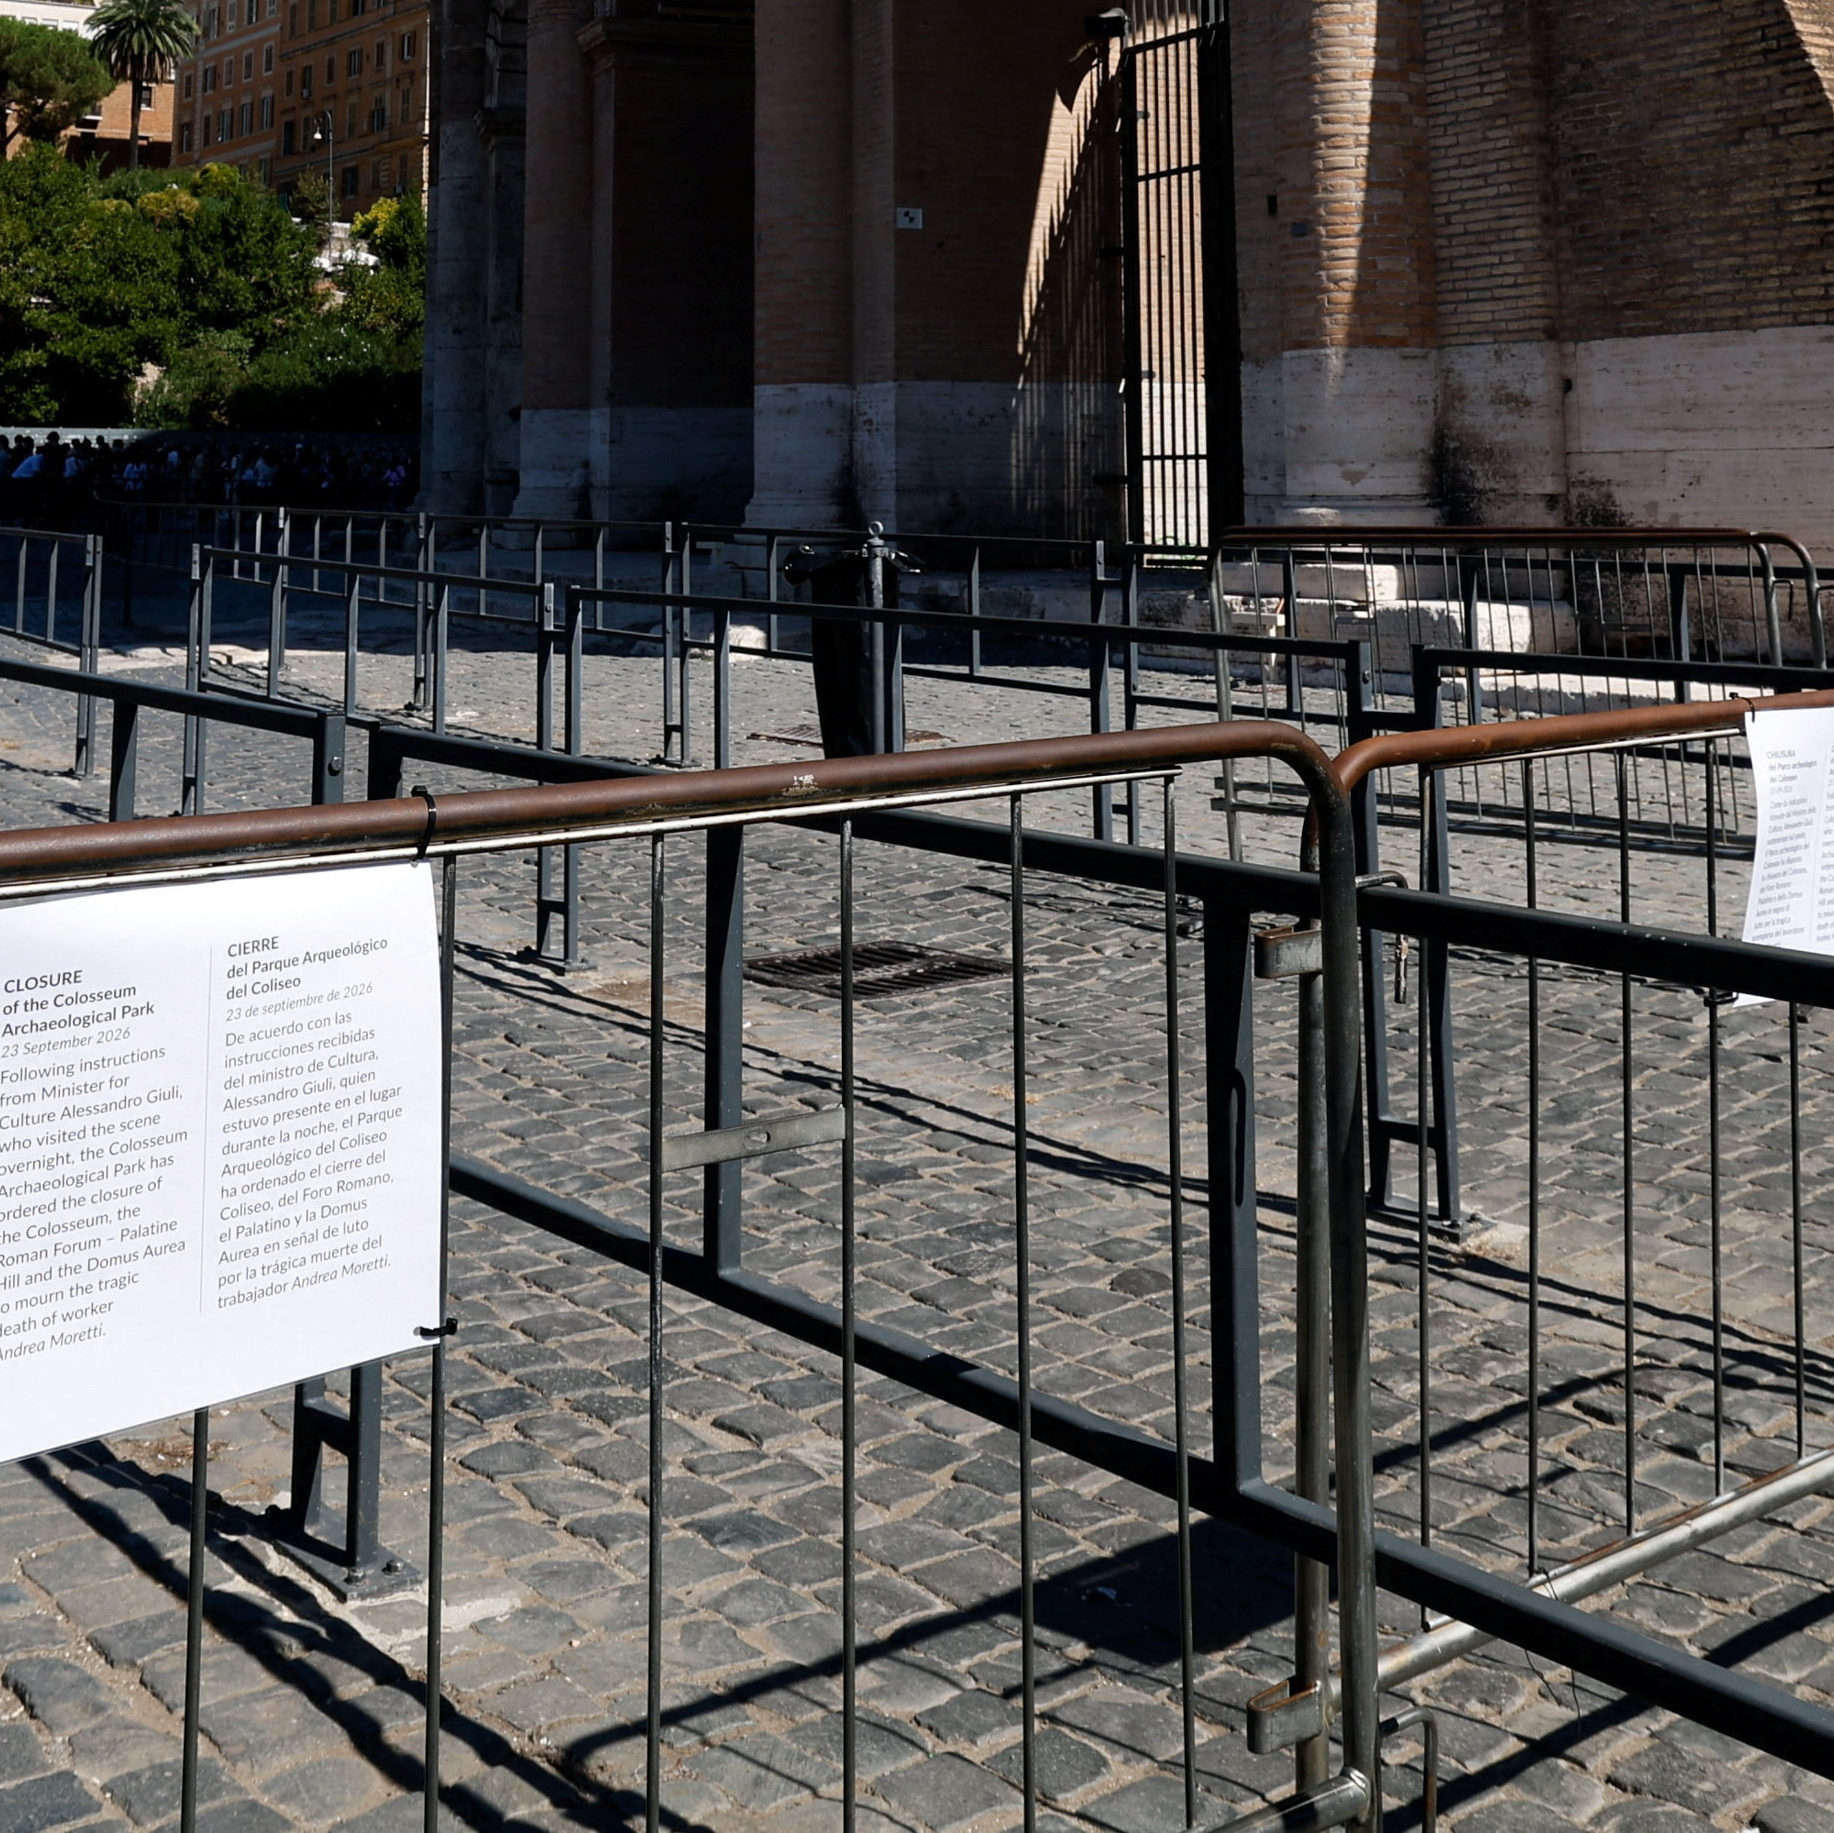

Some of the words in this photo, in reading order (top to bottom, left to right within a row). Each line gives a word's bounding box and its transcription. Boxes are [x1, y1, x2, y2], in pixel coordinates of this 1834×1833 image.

[227, 962, 248, 979] del
[252, 957, 299, 974] Parque
[302, 938, 387, 965] Arqueológico
[228, 936, 279, 957] CIERRE
[4, 970, 83, 993] CLOSURE
[226, 983, 247, 1000] del
[251, 977, 301, 995] Coliseo
[3, 1000, 20, 1015] of
[23, 998, 49, 1012] the
[53, 986, 136, 1008] Colosseum
[226, 1007, 241, 1022] 23
[245, 1005, 259, 1018] de
[262, 994, 324, 1014] septiembre
[327, 989, 340, 1002] de
[344, 982, 372, 998] 2026
[1, 1006, 117, 1038] Archaeological
[122, 1001, 154, 1019] Park
[1, 1044, 19, 1058] 23
[23, 1035, 93, 1055] September
[96, 1026, 130, 1044] 2026
[1, 1063, 75, 1084] Following
[80, 1048, 165, 1072] instructions
[0, 1092, 36, 1107] from
[42, 1081, 105, 1101] Minister
[109, 1075, 130, 1090] for
[0, 1112, 56, 1130] Culture
[60, 1095, 142, 1121] Alessandro
[147, 1085, 182, 1103] Giuli,
[37, 1125, 86, 1146] visited
[91, 1122, 115, 1137] the
[120, 1114, 161, 1132] scene
[80, 1147, 104, 1162] the
[109, 1131, 187, 1156] Colosseum
[114, 1158, 146, 1177] Park
[150, 1155, 174, 1169] has
[218, 1272, 242, 1290] por
[246, 1266, 256, 1280] la
[261, 1256, 306, 1276] trágica
[311, 1243, 358, 1264] muerte
[362, 1234, 382, 1251] del
[218, 1282, 289, 1308] trabajador
[291, 1270, 338, 1290] Andrea
[342, 1254, 390, 1278] Moretti.
